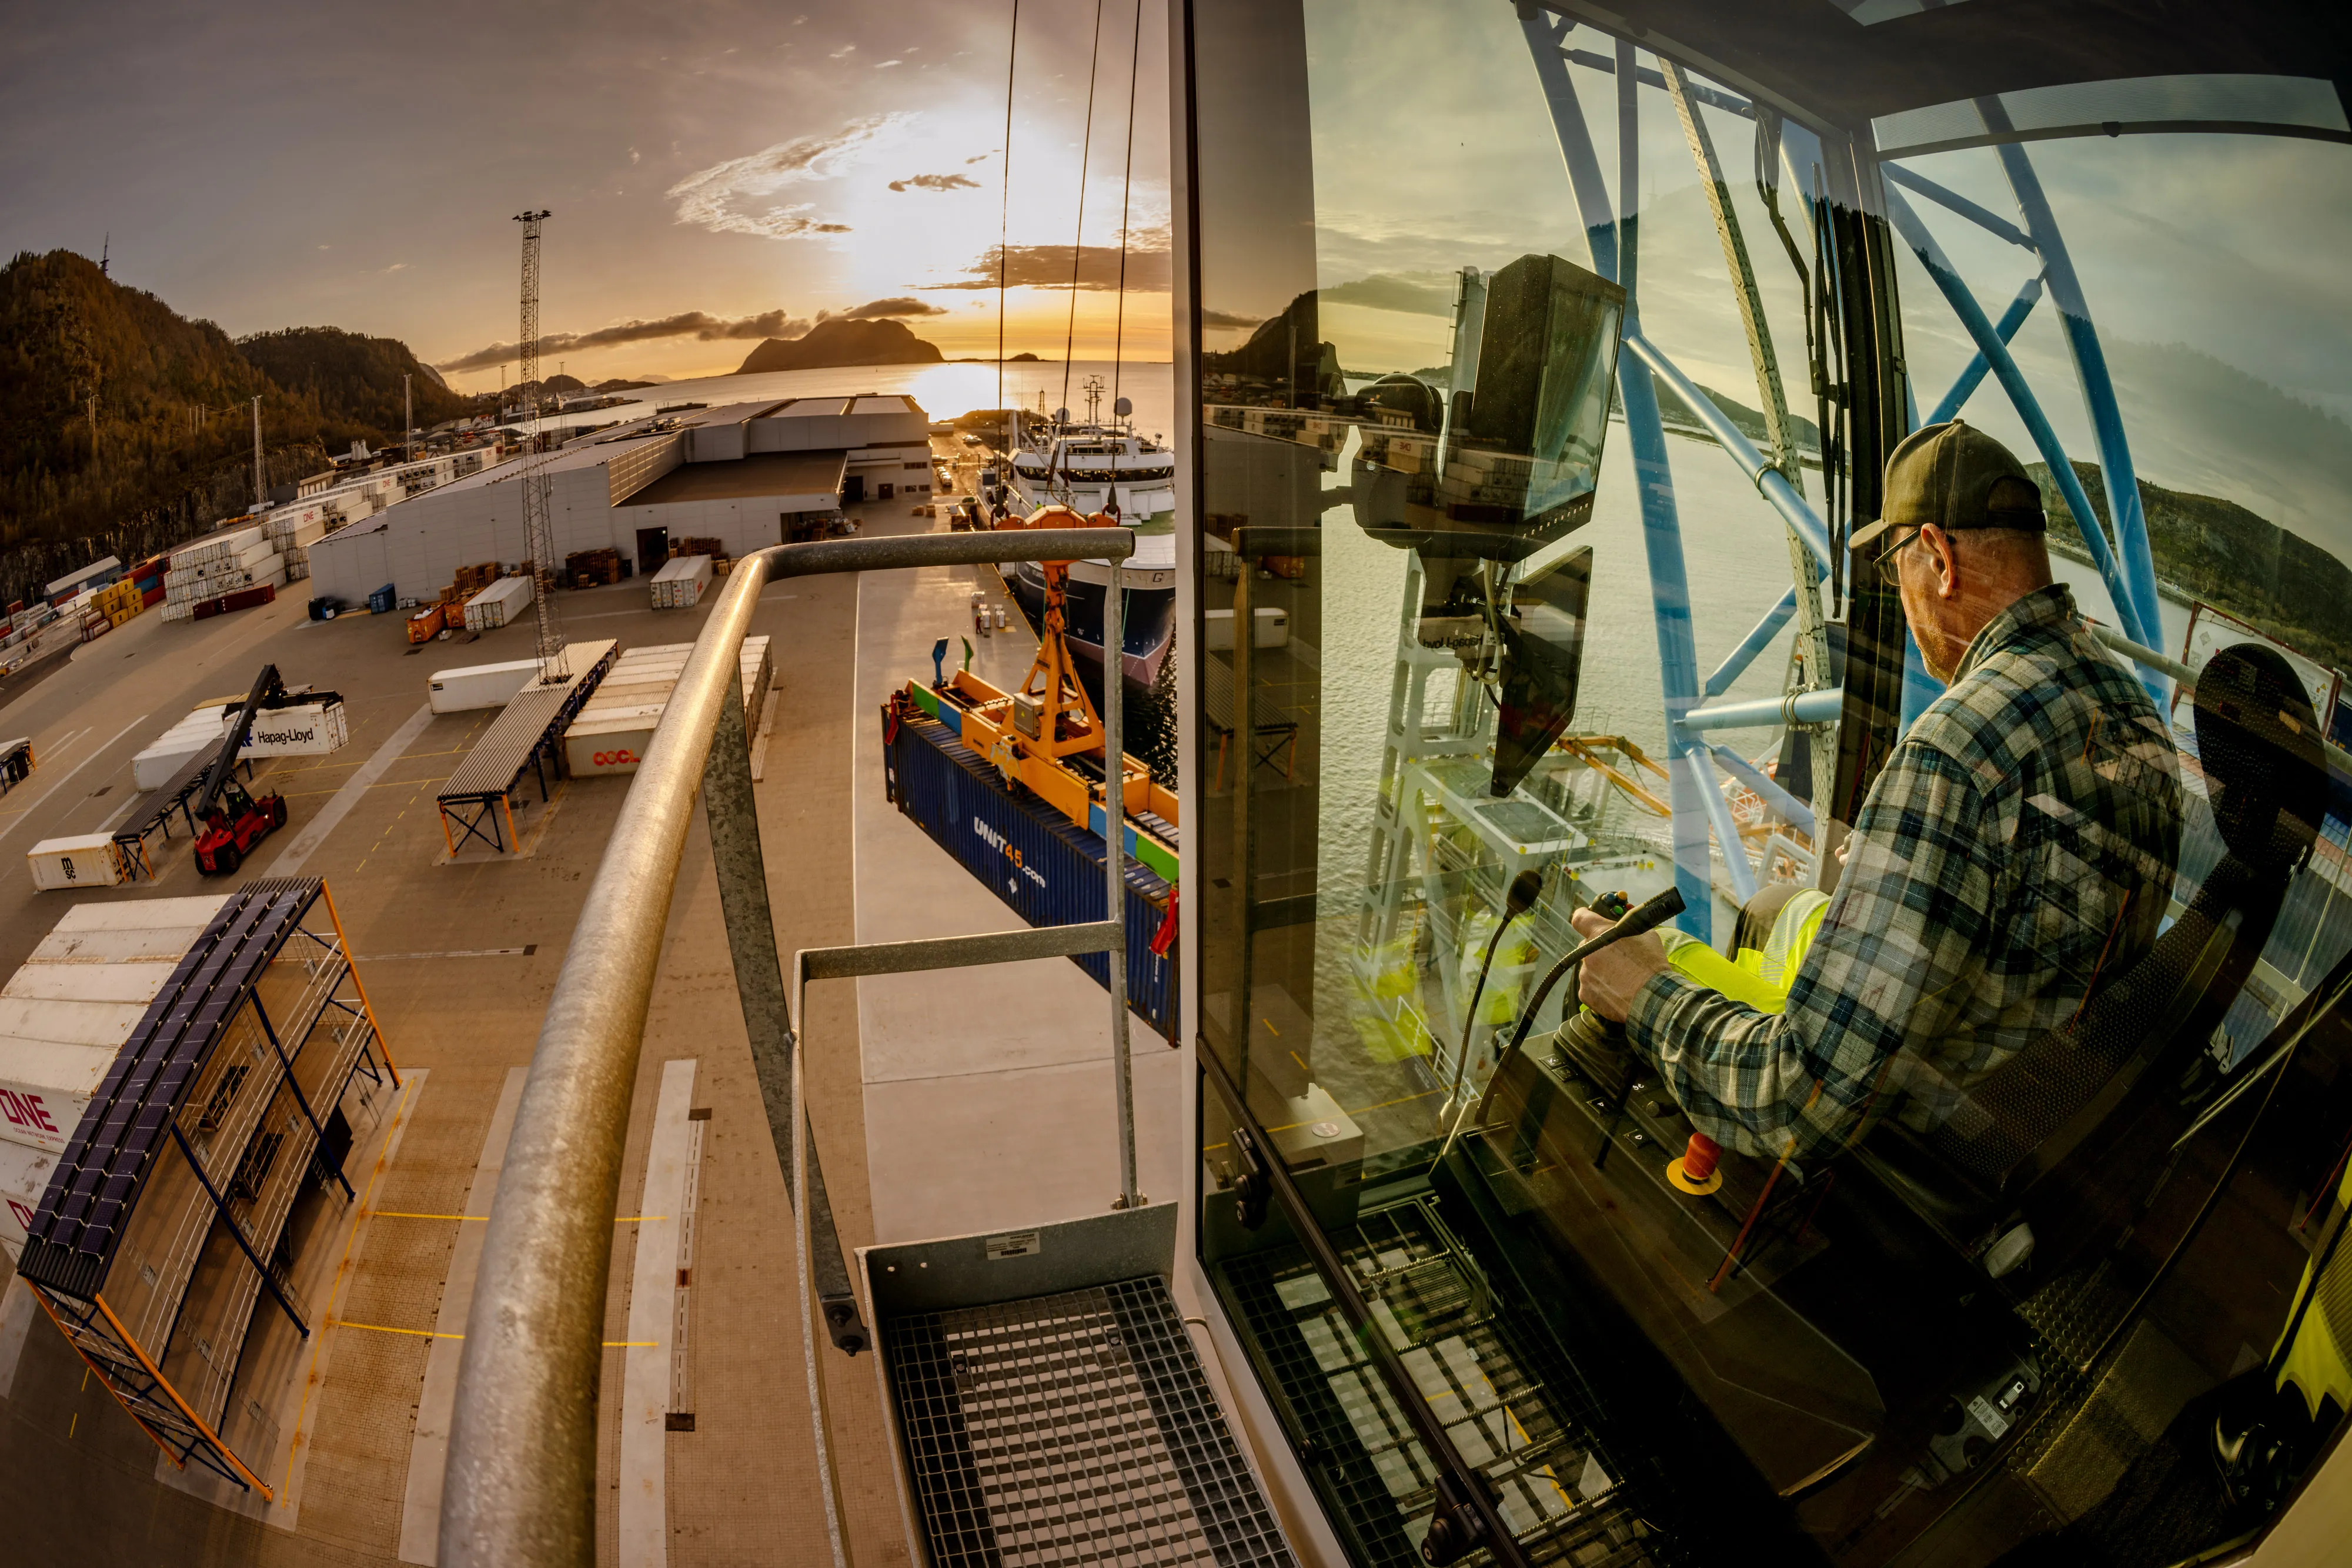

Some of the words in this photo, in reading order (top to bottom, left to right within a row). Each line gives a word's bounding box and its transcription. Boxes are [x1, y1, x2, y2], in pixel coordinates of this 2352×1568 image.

[303, 510, 314, 523] ONE
[258, 728, 314, 746] Hapag-Lloyd
[592, 748, 640, 767] OOCL
[0, 1088, 59, 1134] ONE
[13, 1126, 27, 1135] OCEAN
[27, 1129, 46, 1139] NETWORK
[46, 1135, 65, 1144] EXPRESS
